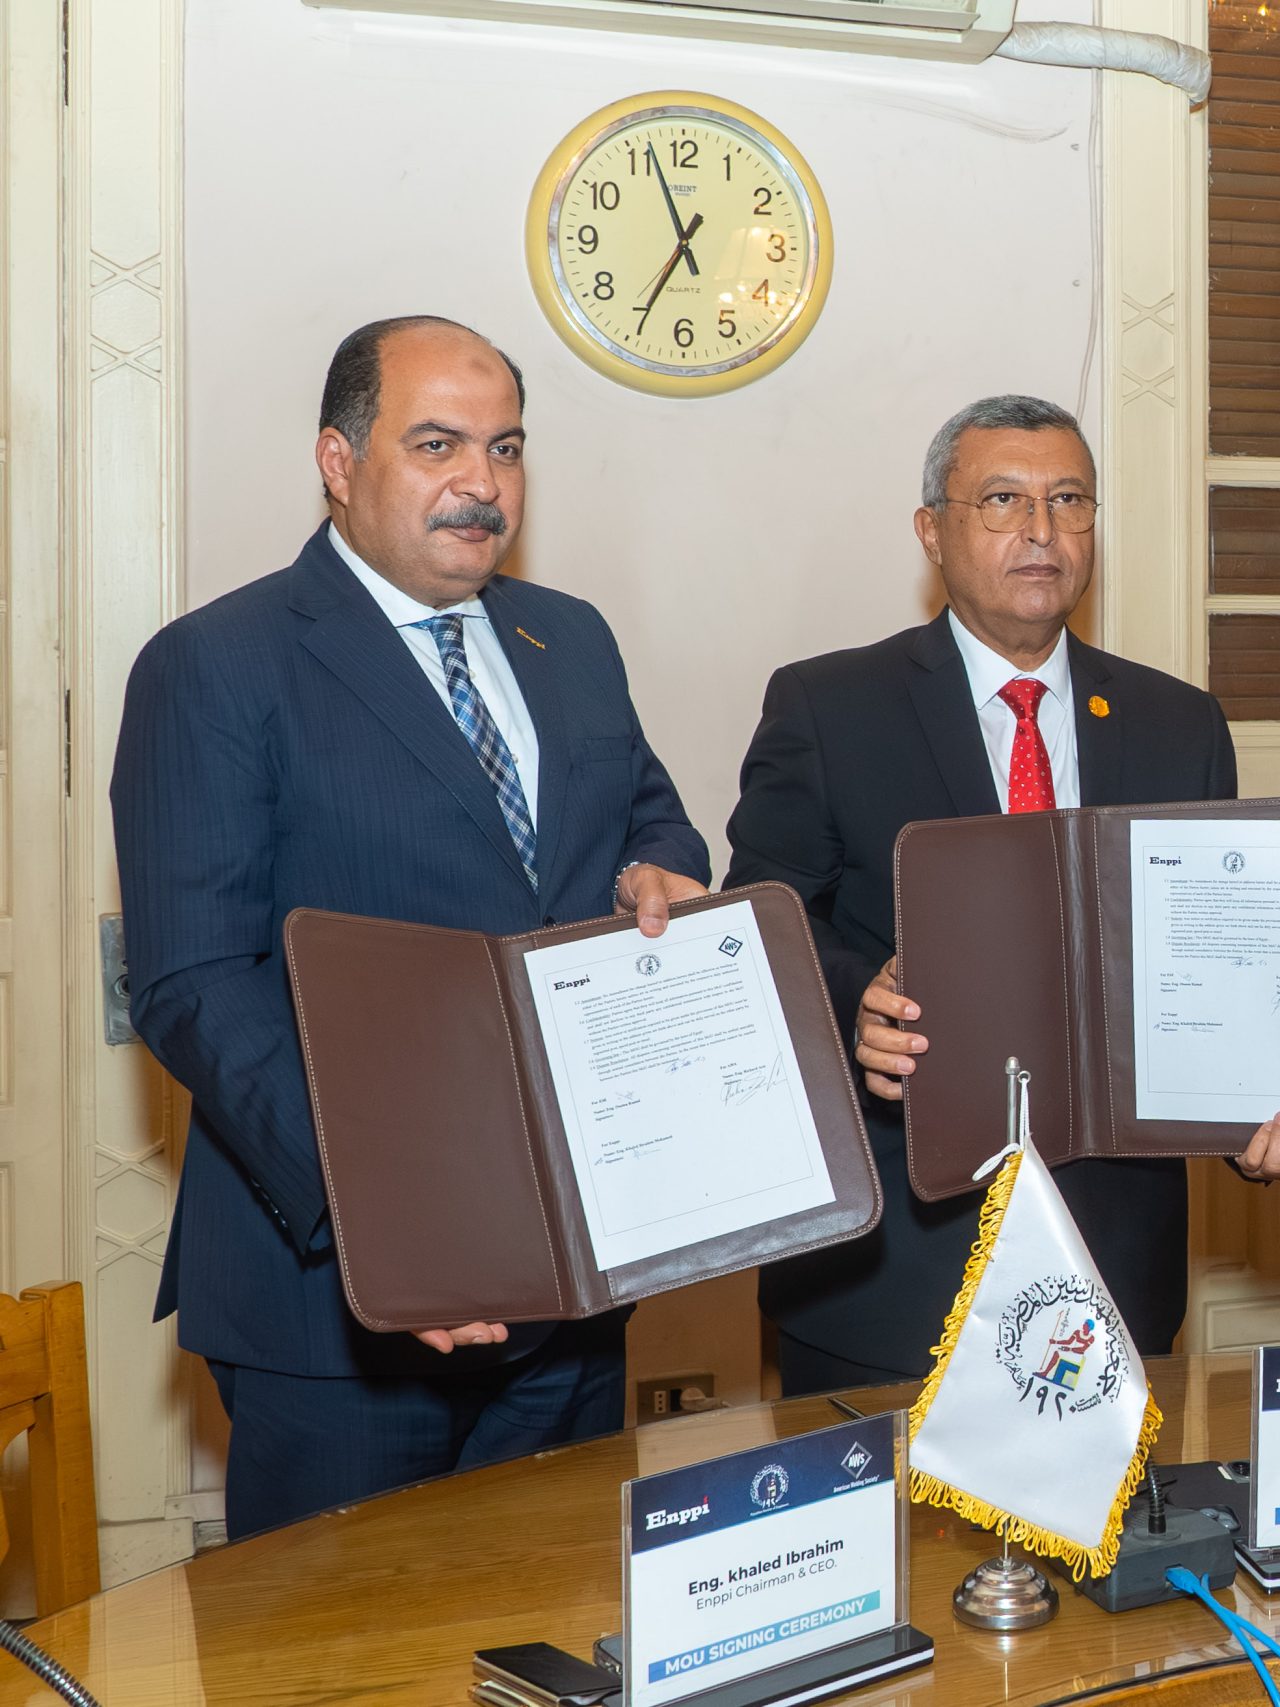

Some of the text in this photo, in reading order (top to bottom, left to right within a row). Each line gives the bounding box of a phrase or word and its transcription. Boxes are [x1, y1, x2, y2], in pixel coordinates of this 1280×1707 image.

[628, 148, 650, 176] 11
[669, 140, 699, 169] 12
[722, 154, 731, 181] 1
[589, 181, 620, 211] 10
[753, 187, 773, 216] 2
[578, 224, 599, 255] 9
[765, 234, 787, 263] 3
[593, 271, 615, 301] 8
[666, 286, 701, 294] QUARTZ
[751, 279, 770, 307] 4
[632, 306, 651, 336] 7
[673, 318, 694, 348] 6
[718, 309, 736, 338] 5
[1149, 855, 1182, 866] Enppi
[724, 941, 739, 951] AWS
[553, 974, 591, 992] Enppi
[848, 1452, 865, 1468] AWS
[645, 1496, 710, 1531] Enppi
[688, 1538, 844, 1595] Eng. khaled Ibrahim
[696, 1558, 837, 1610] Enppi Chairman & CEO.
[665, 1598, 867, 1676] MOU SIGNING CEREMONY
